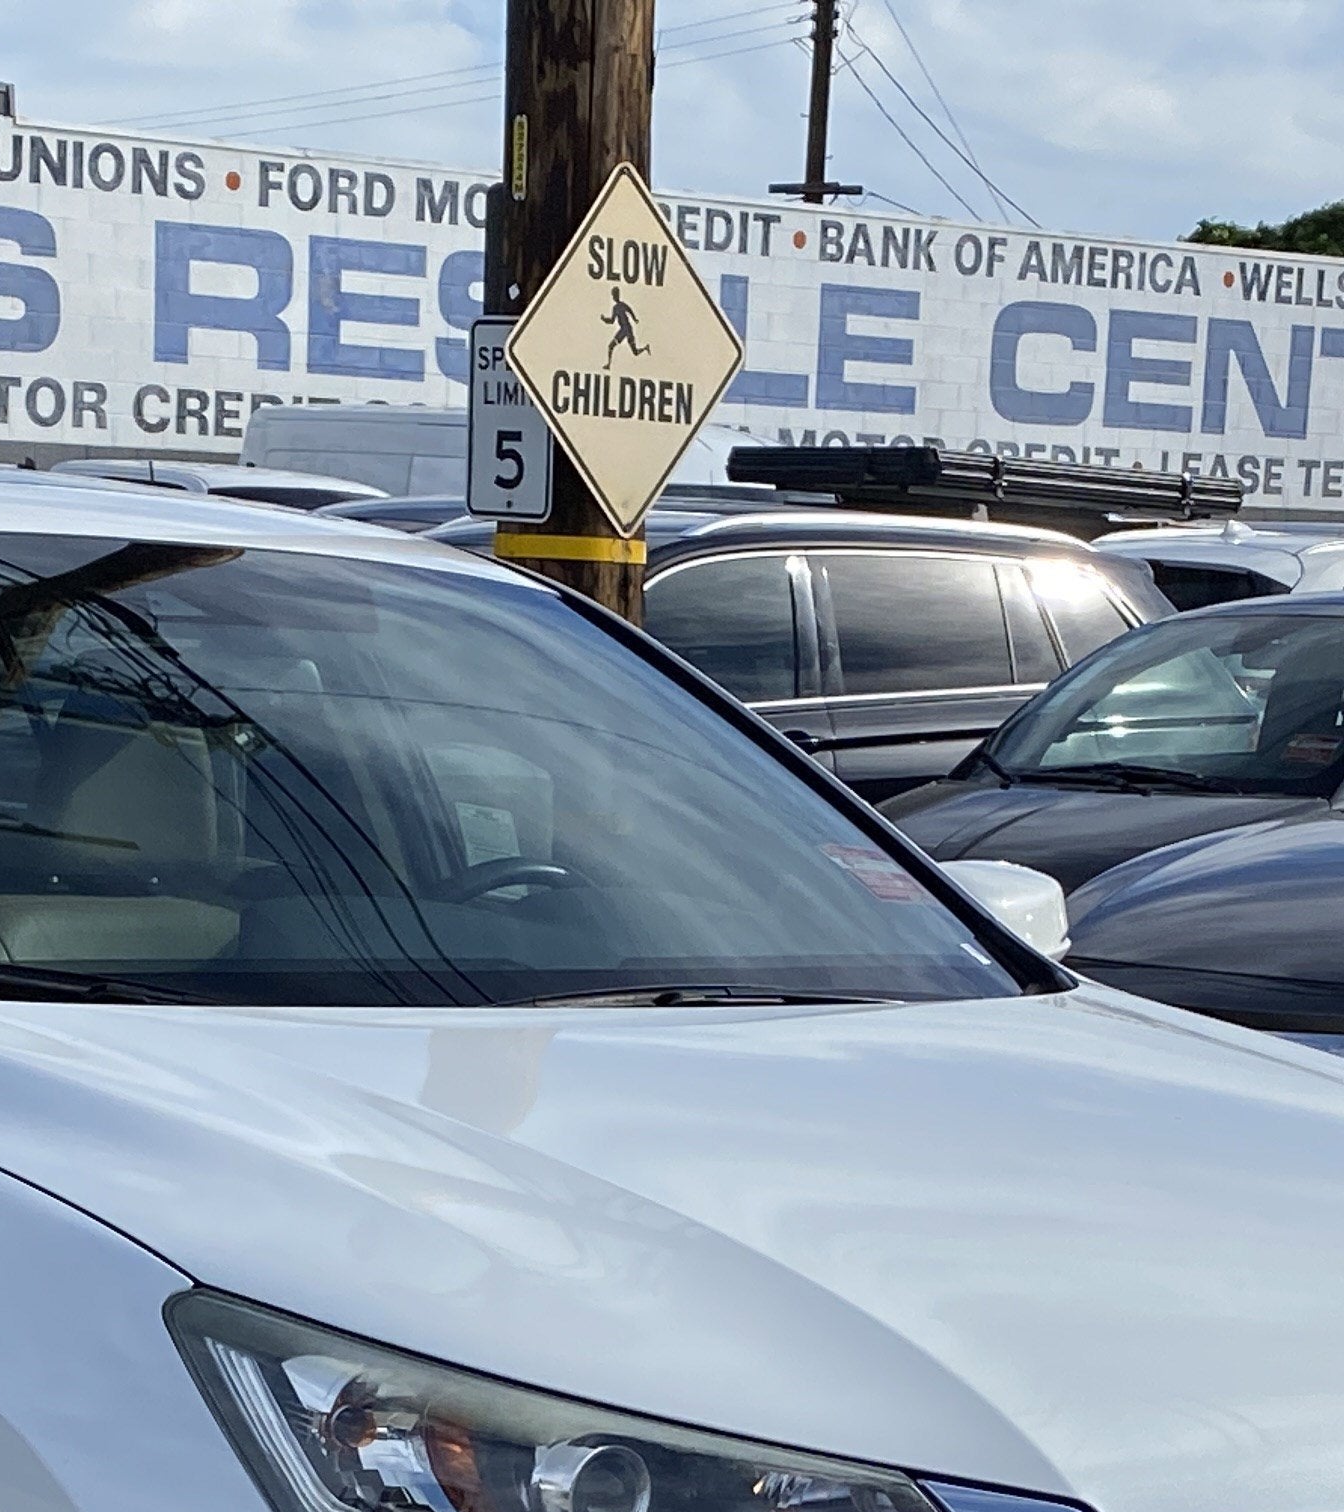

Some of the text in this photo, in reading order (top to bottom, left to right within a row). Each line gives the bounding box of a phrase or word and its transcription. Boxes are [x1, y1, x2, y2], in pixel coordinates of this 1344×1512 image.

[257, 160, 397, 218] FORD
[659, 203, 781, 257] EDIT
[818, 219, 938, 273] BANK
[954, 233, 1009, 279] OF
[1017, 240, 1201, 297] AMERICA
[587, 234, 668, 287] SLOW
[154, 219, 922, 415] RELE
[483, 380, 535, 408] LIMI
[551, 369, 693, 425] CHILDREN
[493, 429, 526, 490] 5
